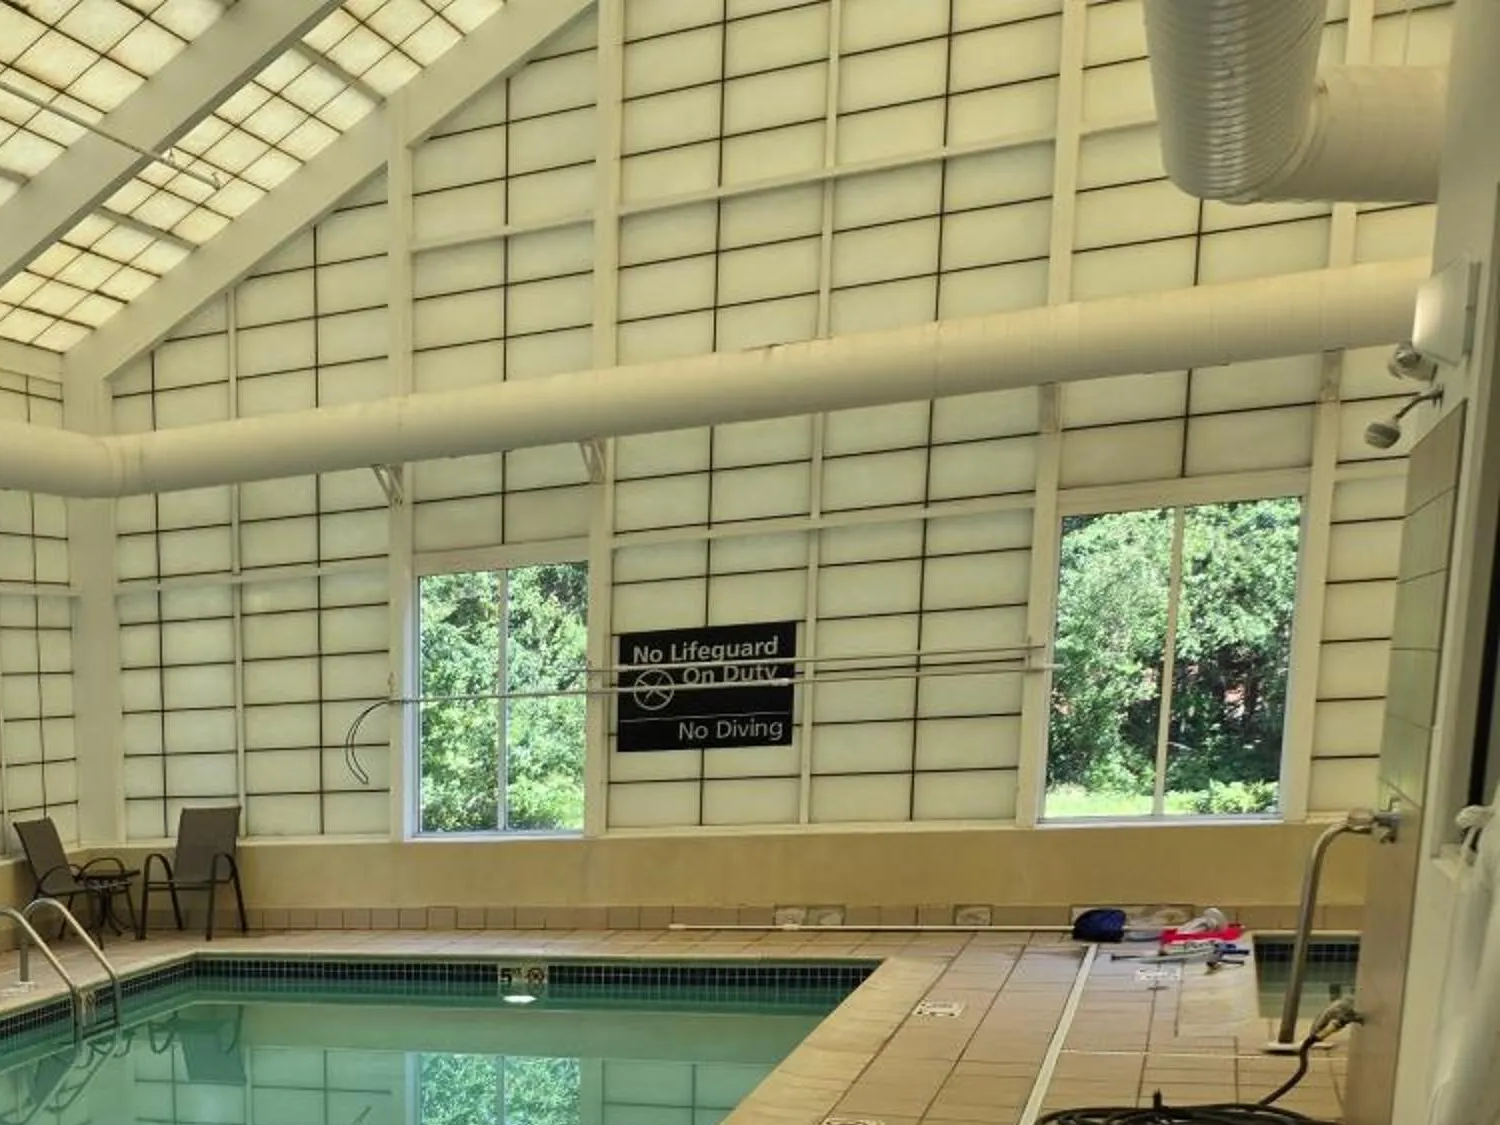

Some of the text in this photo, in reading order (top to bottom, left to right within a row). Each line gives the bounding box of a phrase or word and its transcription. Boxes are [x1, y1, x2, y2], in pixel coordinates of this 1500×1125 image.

[633, 635, 779, 664] No Lifeguard
[683, 667, 715, 685] On
[679, 718, 784, 741] No Diving
